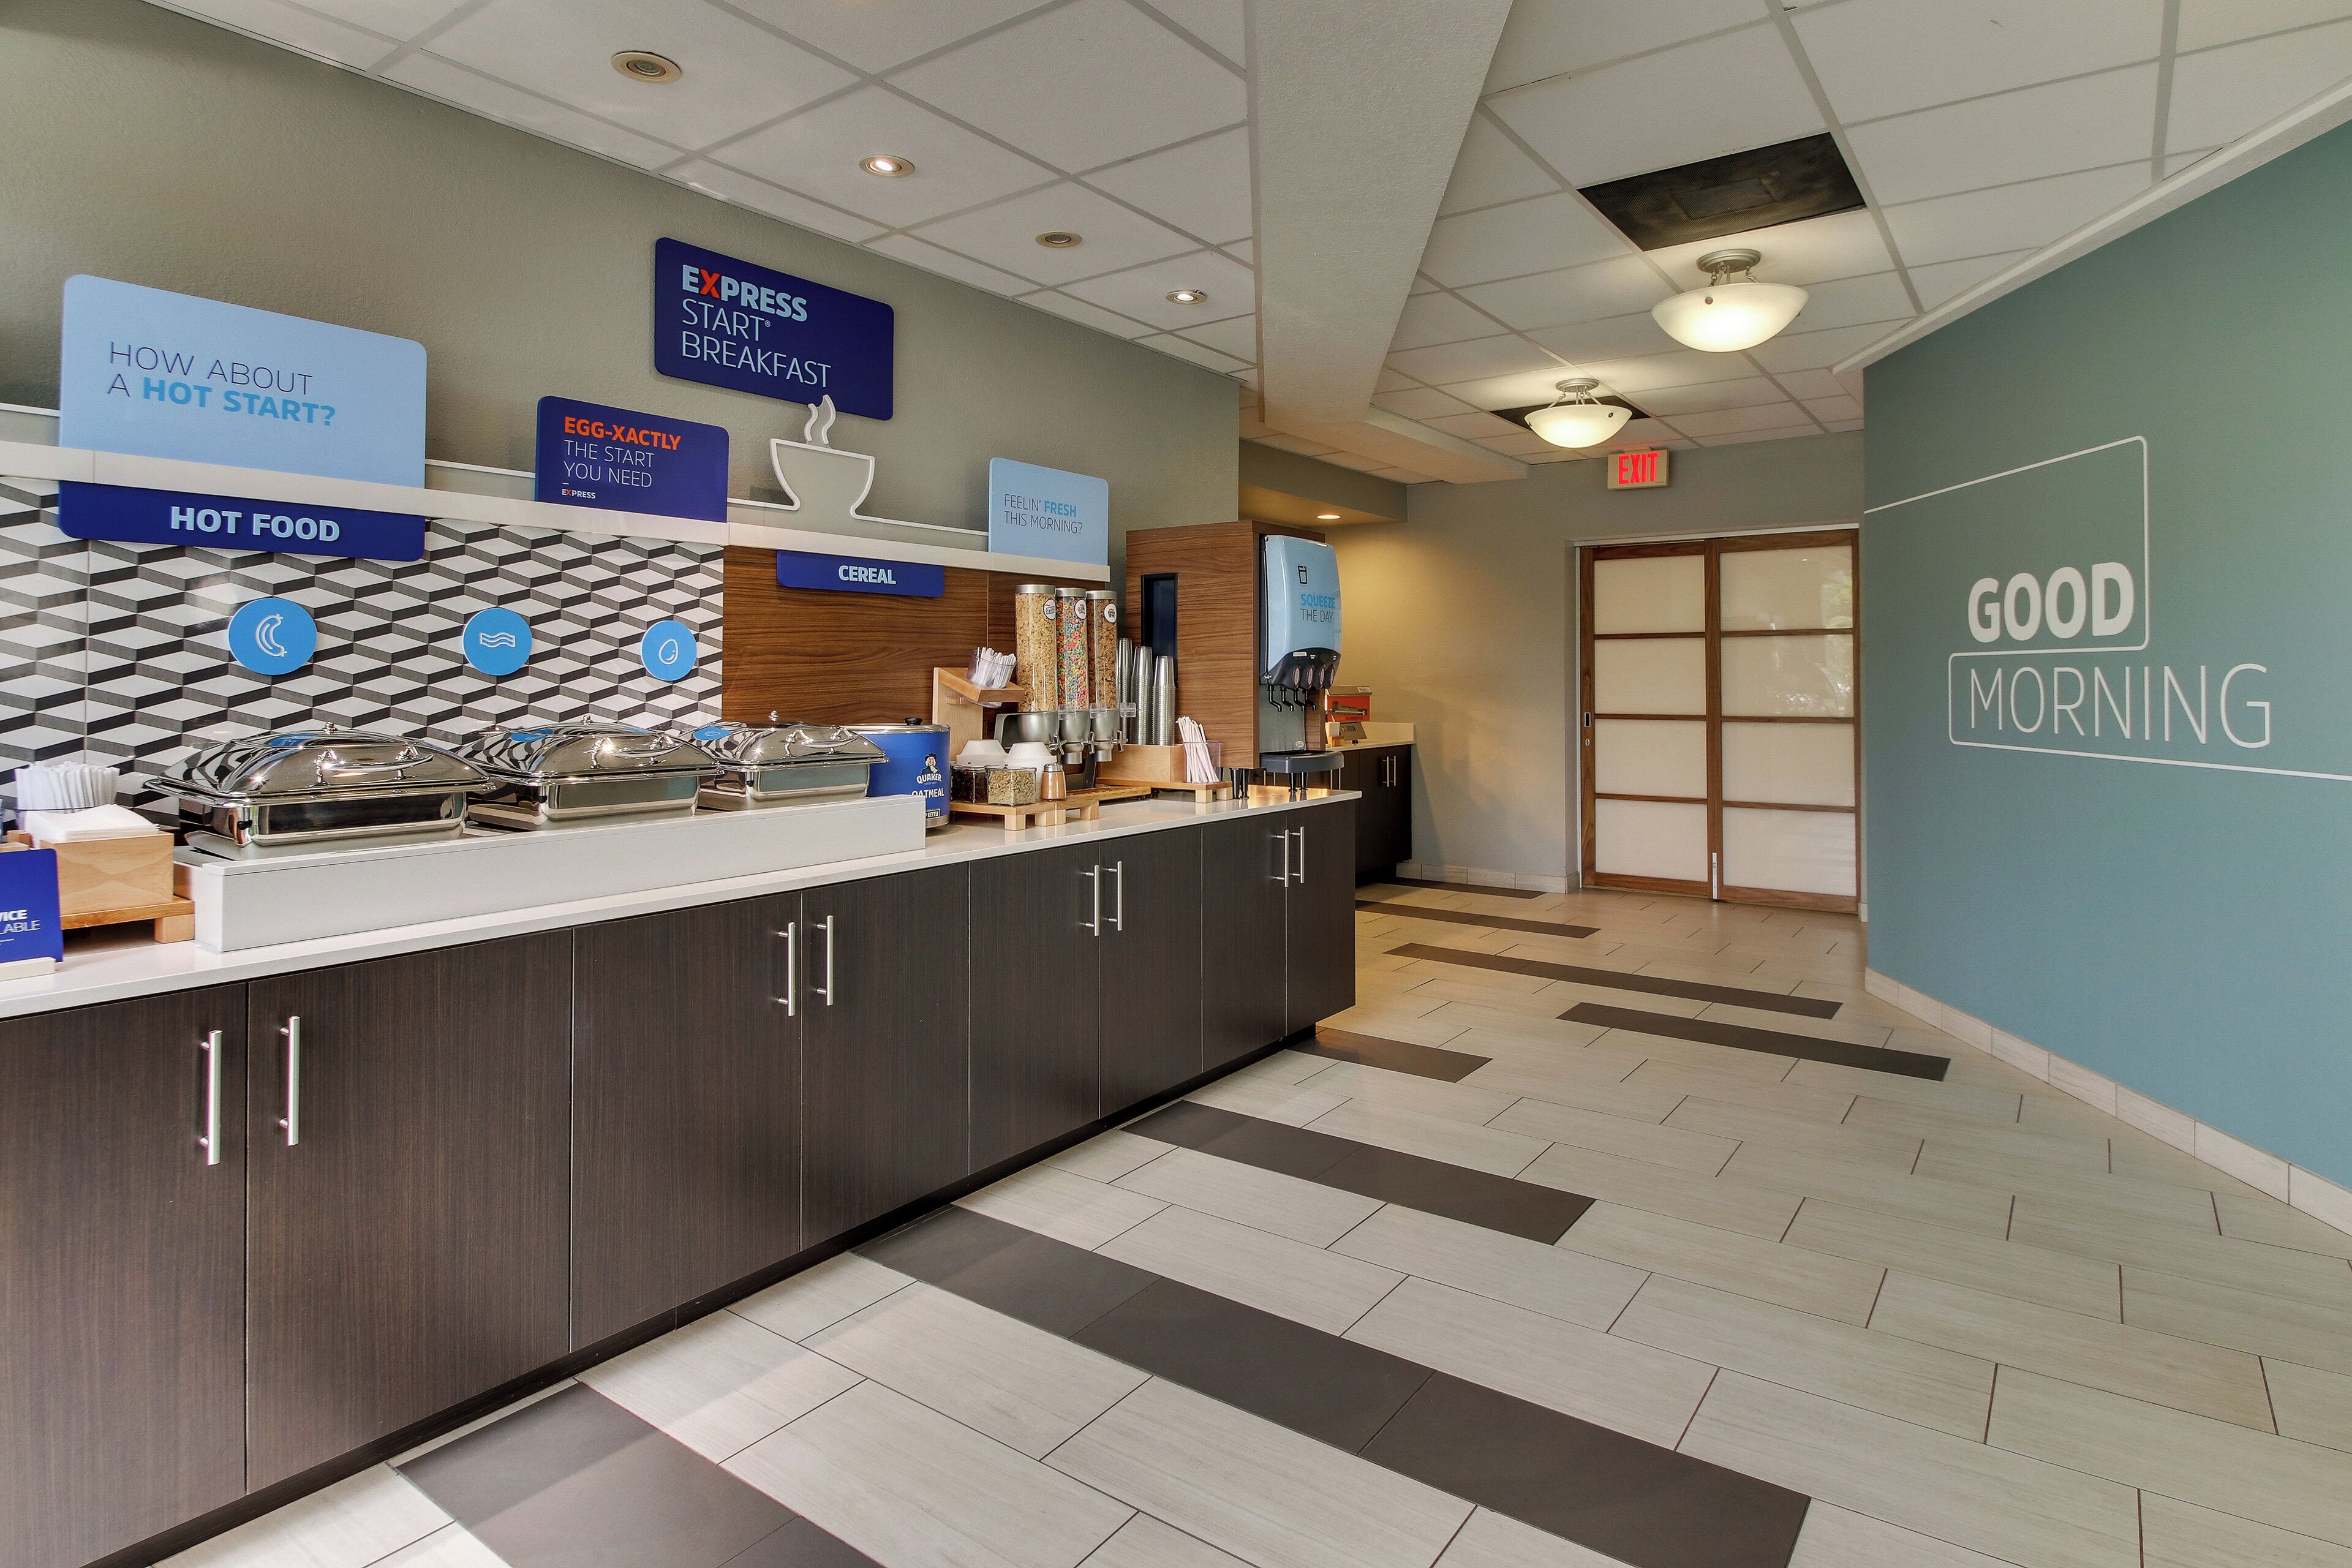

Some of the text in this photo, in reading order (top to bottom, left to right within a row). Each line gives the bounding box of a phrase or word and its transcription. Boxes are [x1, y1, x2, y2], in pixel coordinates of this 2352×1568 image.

[682, 264, 808, 322] EXPRESS
[110, 341, 313, 395] HOW ABOUT
[682, 330, 831, 388] BREAKFAST
[107, 373, 336, 426] A HOT START?
[564, 417, 682, 451] EGG-XACTLY
[564, 439, 655, 468] THE START
[1618, 452, 1659, 484] EXIT
[564, 461, 653, 488] YOU NEED
[562, 488, 596, 499] EXPRESS
[170, 505, 341, 542] HOT FOOD
[1004, 510, 1083, 535] THIS MORNING?
[1044, 500, 1077, 518] FRESH
[838, 565, 897, 585] CEREAL
[1300, 593, 1335, 608] SQUEEZE
[1300, 608, 1333, 623] THE DAY
[1968, 562, 2135, 643] GOOD
[1970, 663, 2271, 748] MORNING
[916, 773, 942, 784] QUAKER
